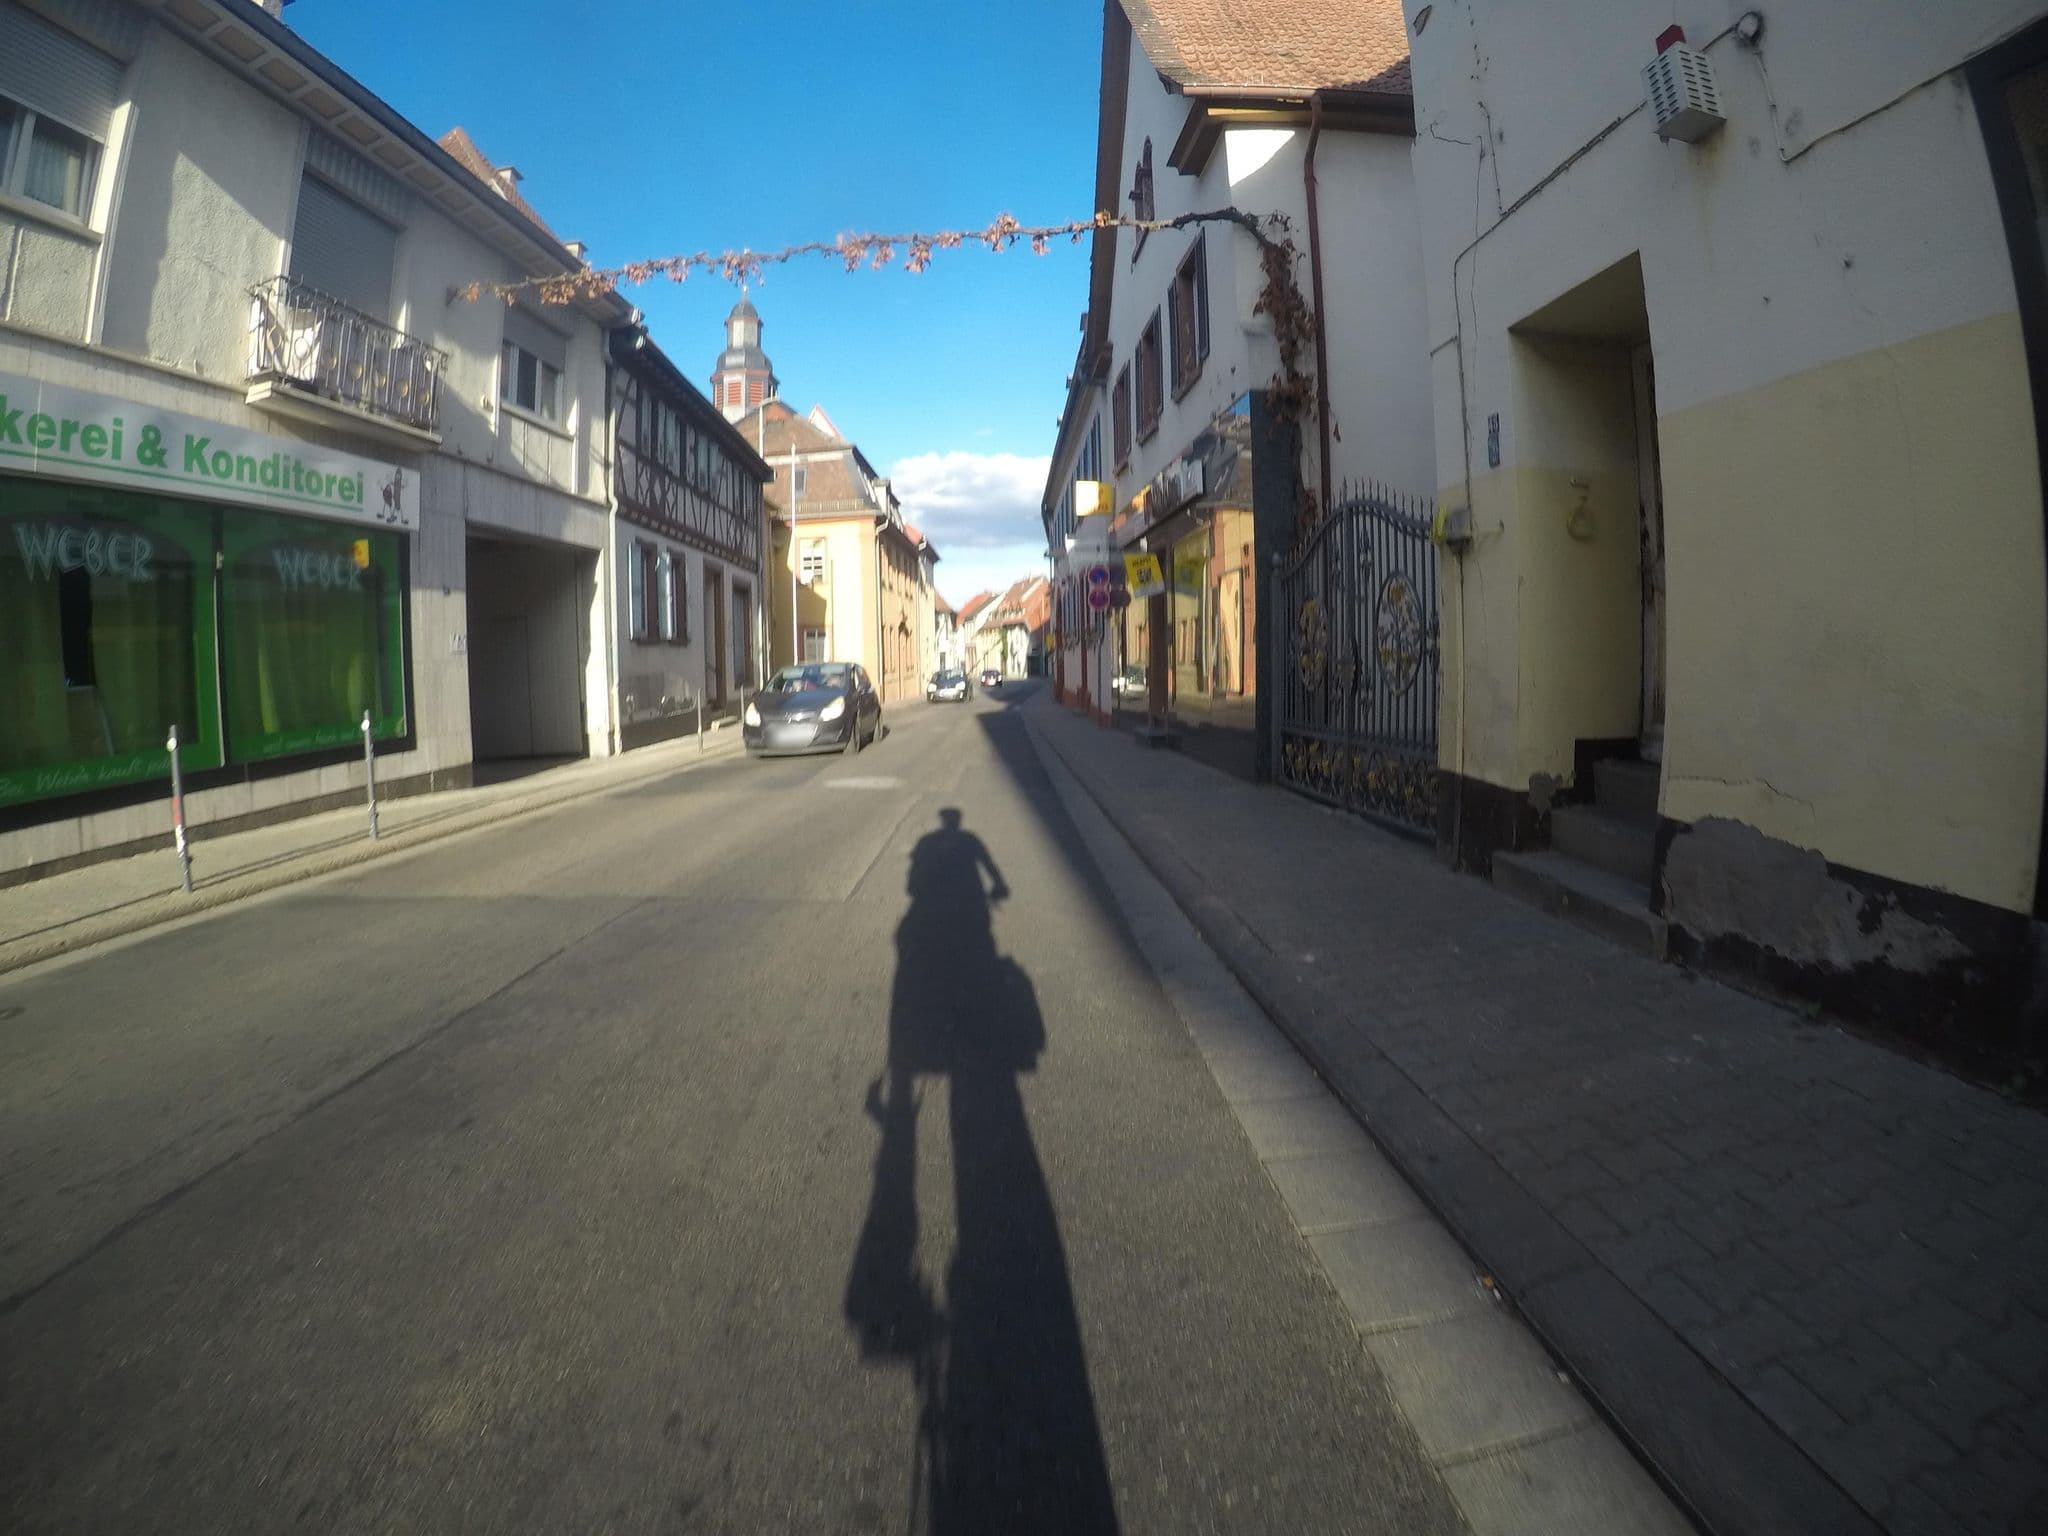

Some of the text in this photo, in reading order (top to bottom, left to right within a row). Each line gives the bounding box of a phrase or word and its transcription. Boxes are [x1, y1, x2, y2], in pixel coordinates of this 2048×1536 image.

[0, 395, 364, 504] kerei & Konditorei
[12, 522, 153, 583] WEBER
